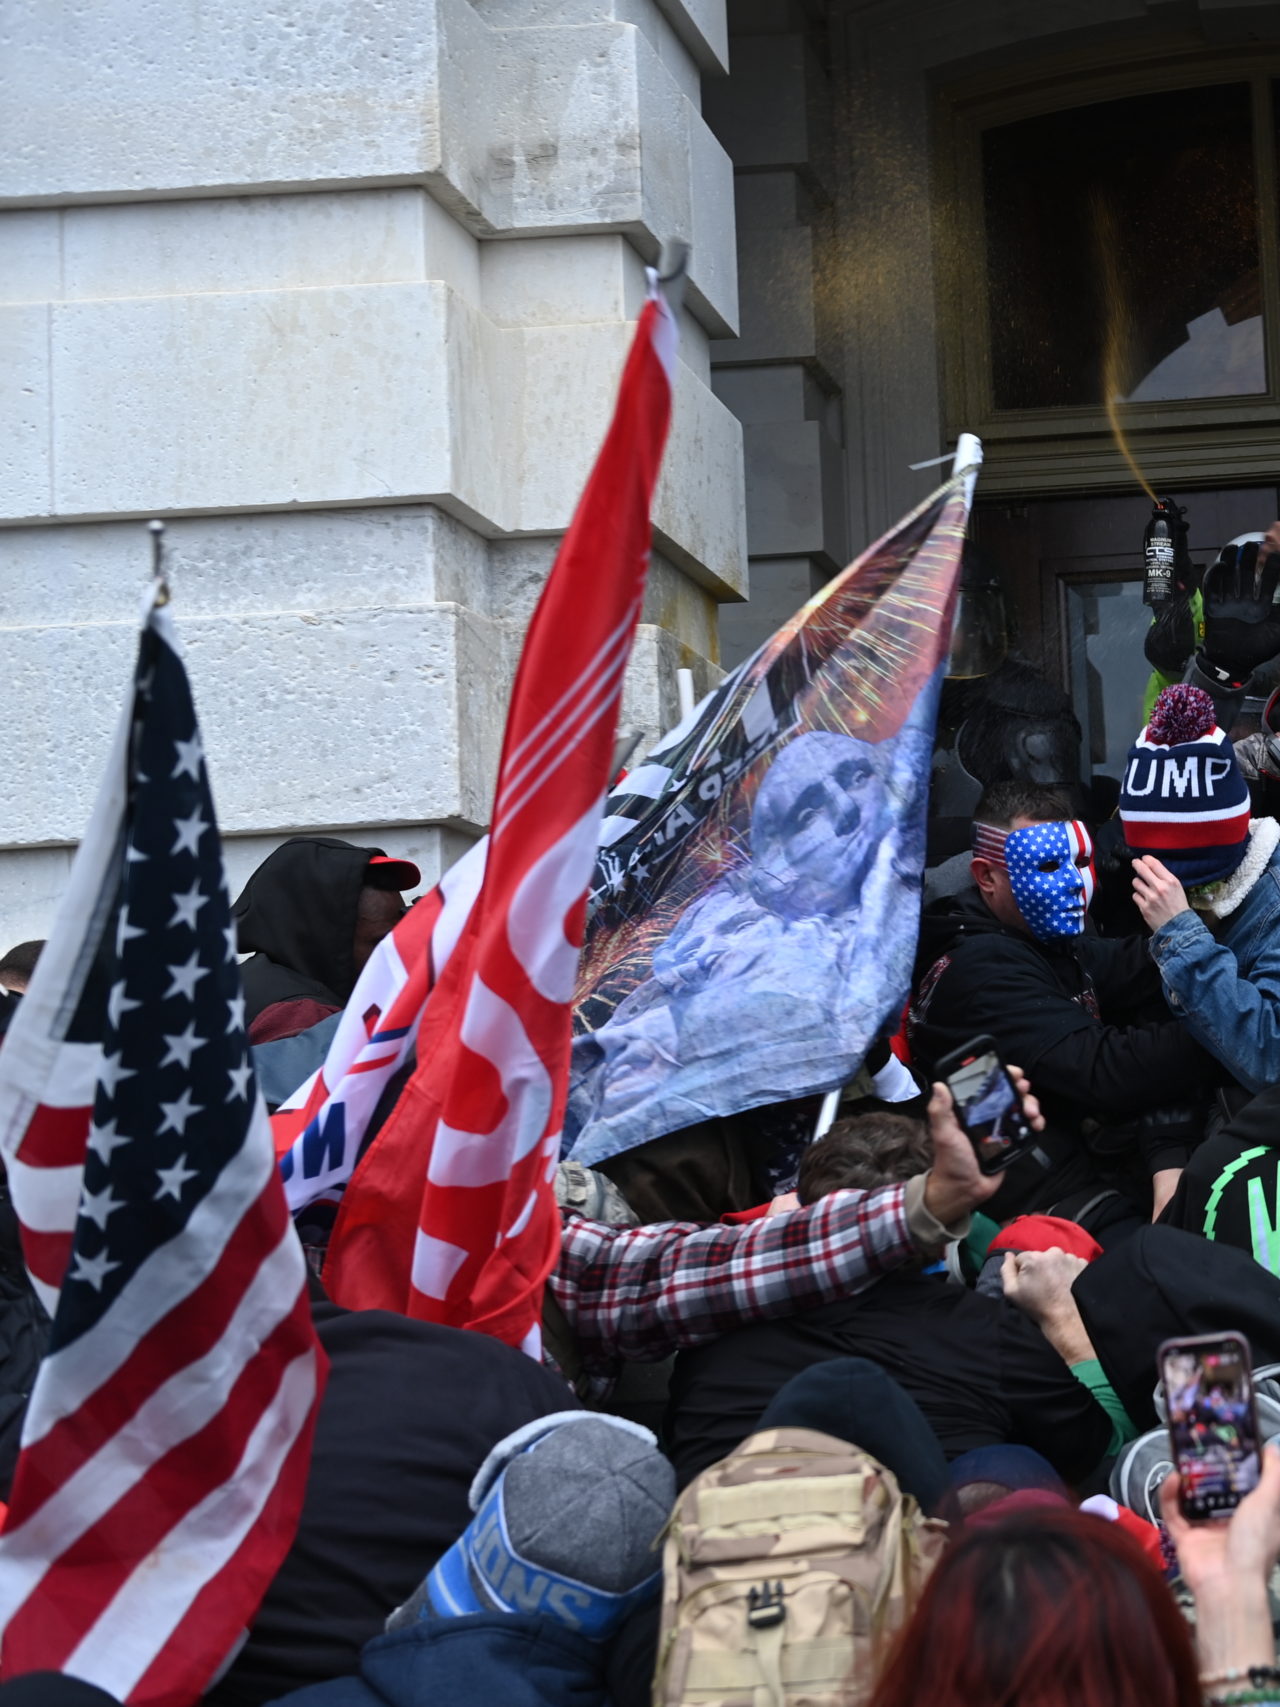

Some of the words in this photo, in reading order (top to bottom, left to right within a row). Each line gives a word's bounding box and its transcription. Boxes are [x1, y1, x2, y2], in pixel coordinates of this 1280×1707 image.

[1148, 569, 1171, 578] MK-9
[1122, 756, 1231, 798] UMP
[472, 1510, 593, 1632] IONS
